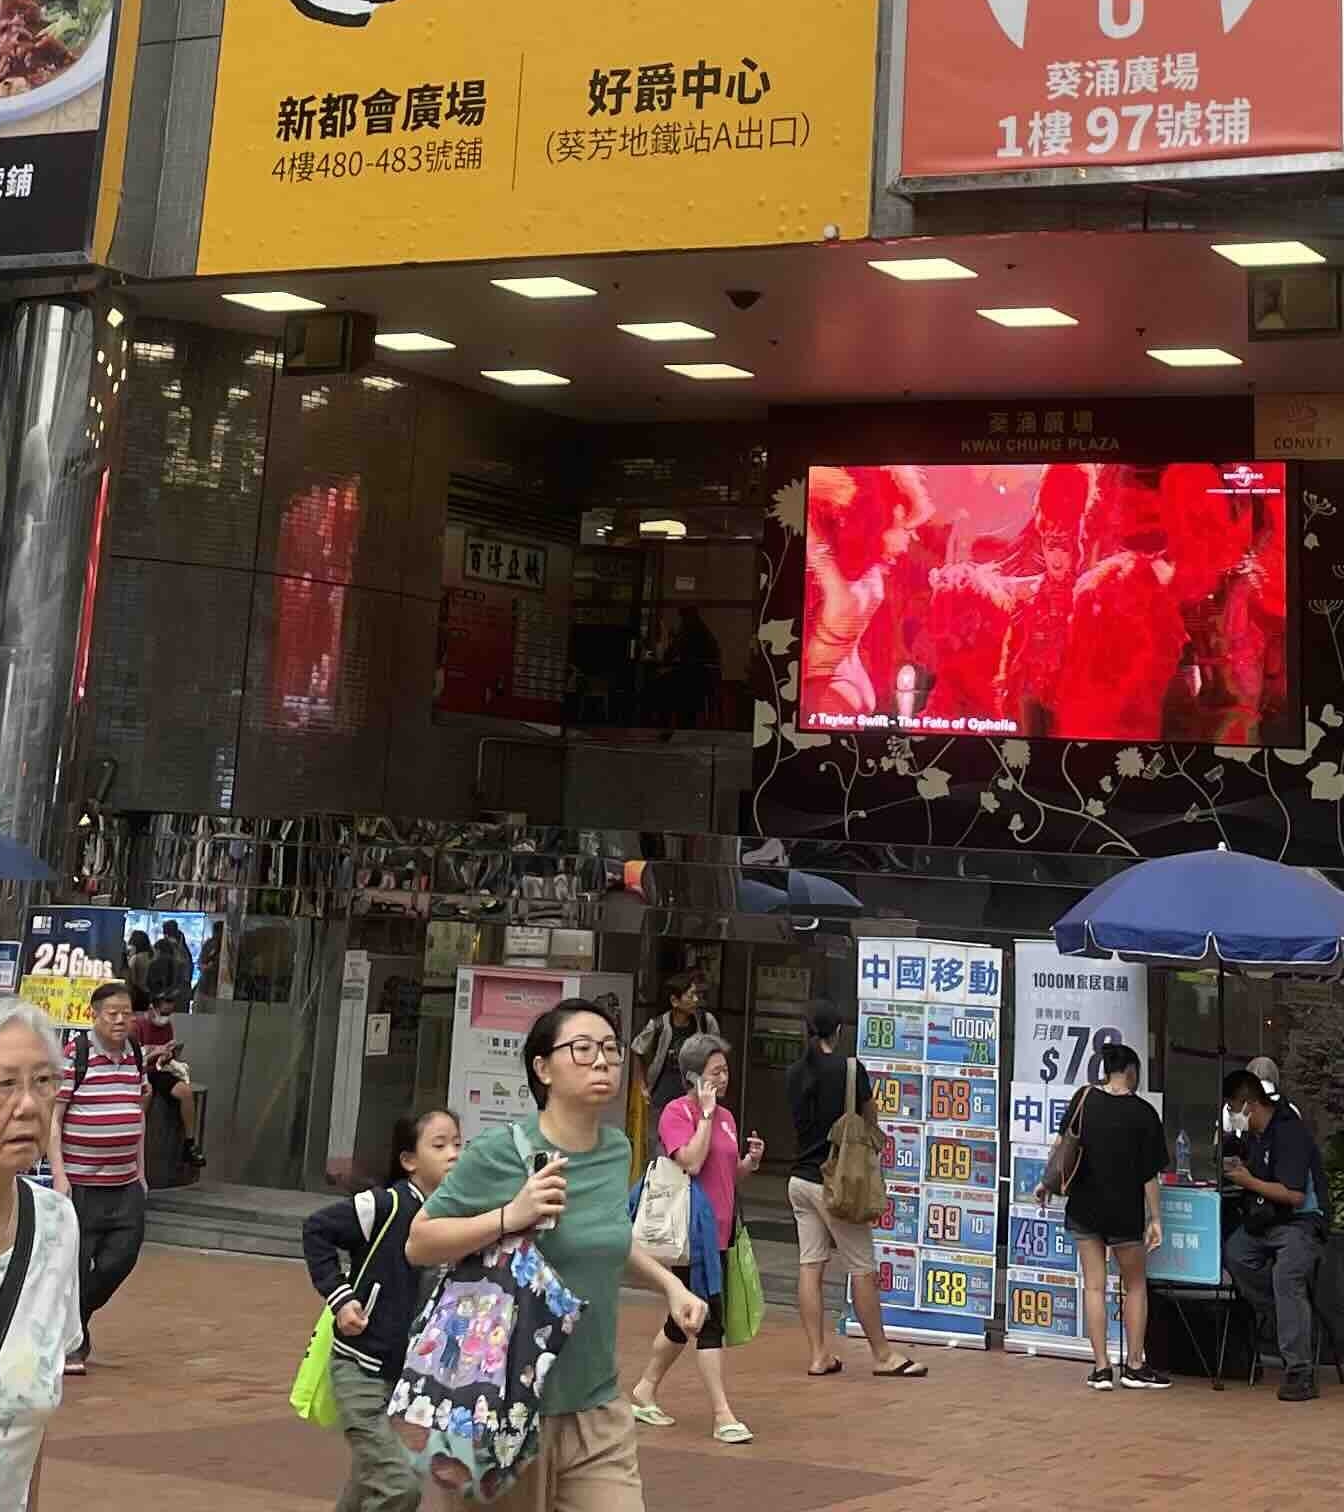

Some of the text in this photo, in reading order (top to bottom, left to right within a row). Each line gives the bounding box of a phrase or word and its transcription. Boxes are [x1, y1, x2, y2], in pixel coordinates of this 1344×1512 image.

[586, 56, 772, 119] 好爵中心
[1045, 52, 1200, 102] 葵涌廣場
[275, 78, 488, 144] 新都會廣場
[996, 110, 1072, 159] 1樓
[544, 111, 813, 165] (葵芳地鐵站A出口)
[960, 436, 1121, 453] KWAI CHUNG PLAZA
[818, 713, 856, 727] Taylor
[857, 714, 889, 728] Swift
[898, 715, 921, 729] The
[922, 717, 950, 730] Fate
[951, 717, 964, 730] of
[862, 952, 1001, 997] 中國移動
[951, 1017, 996, 1040] 1000M
